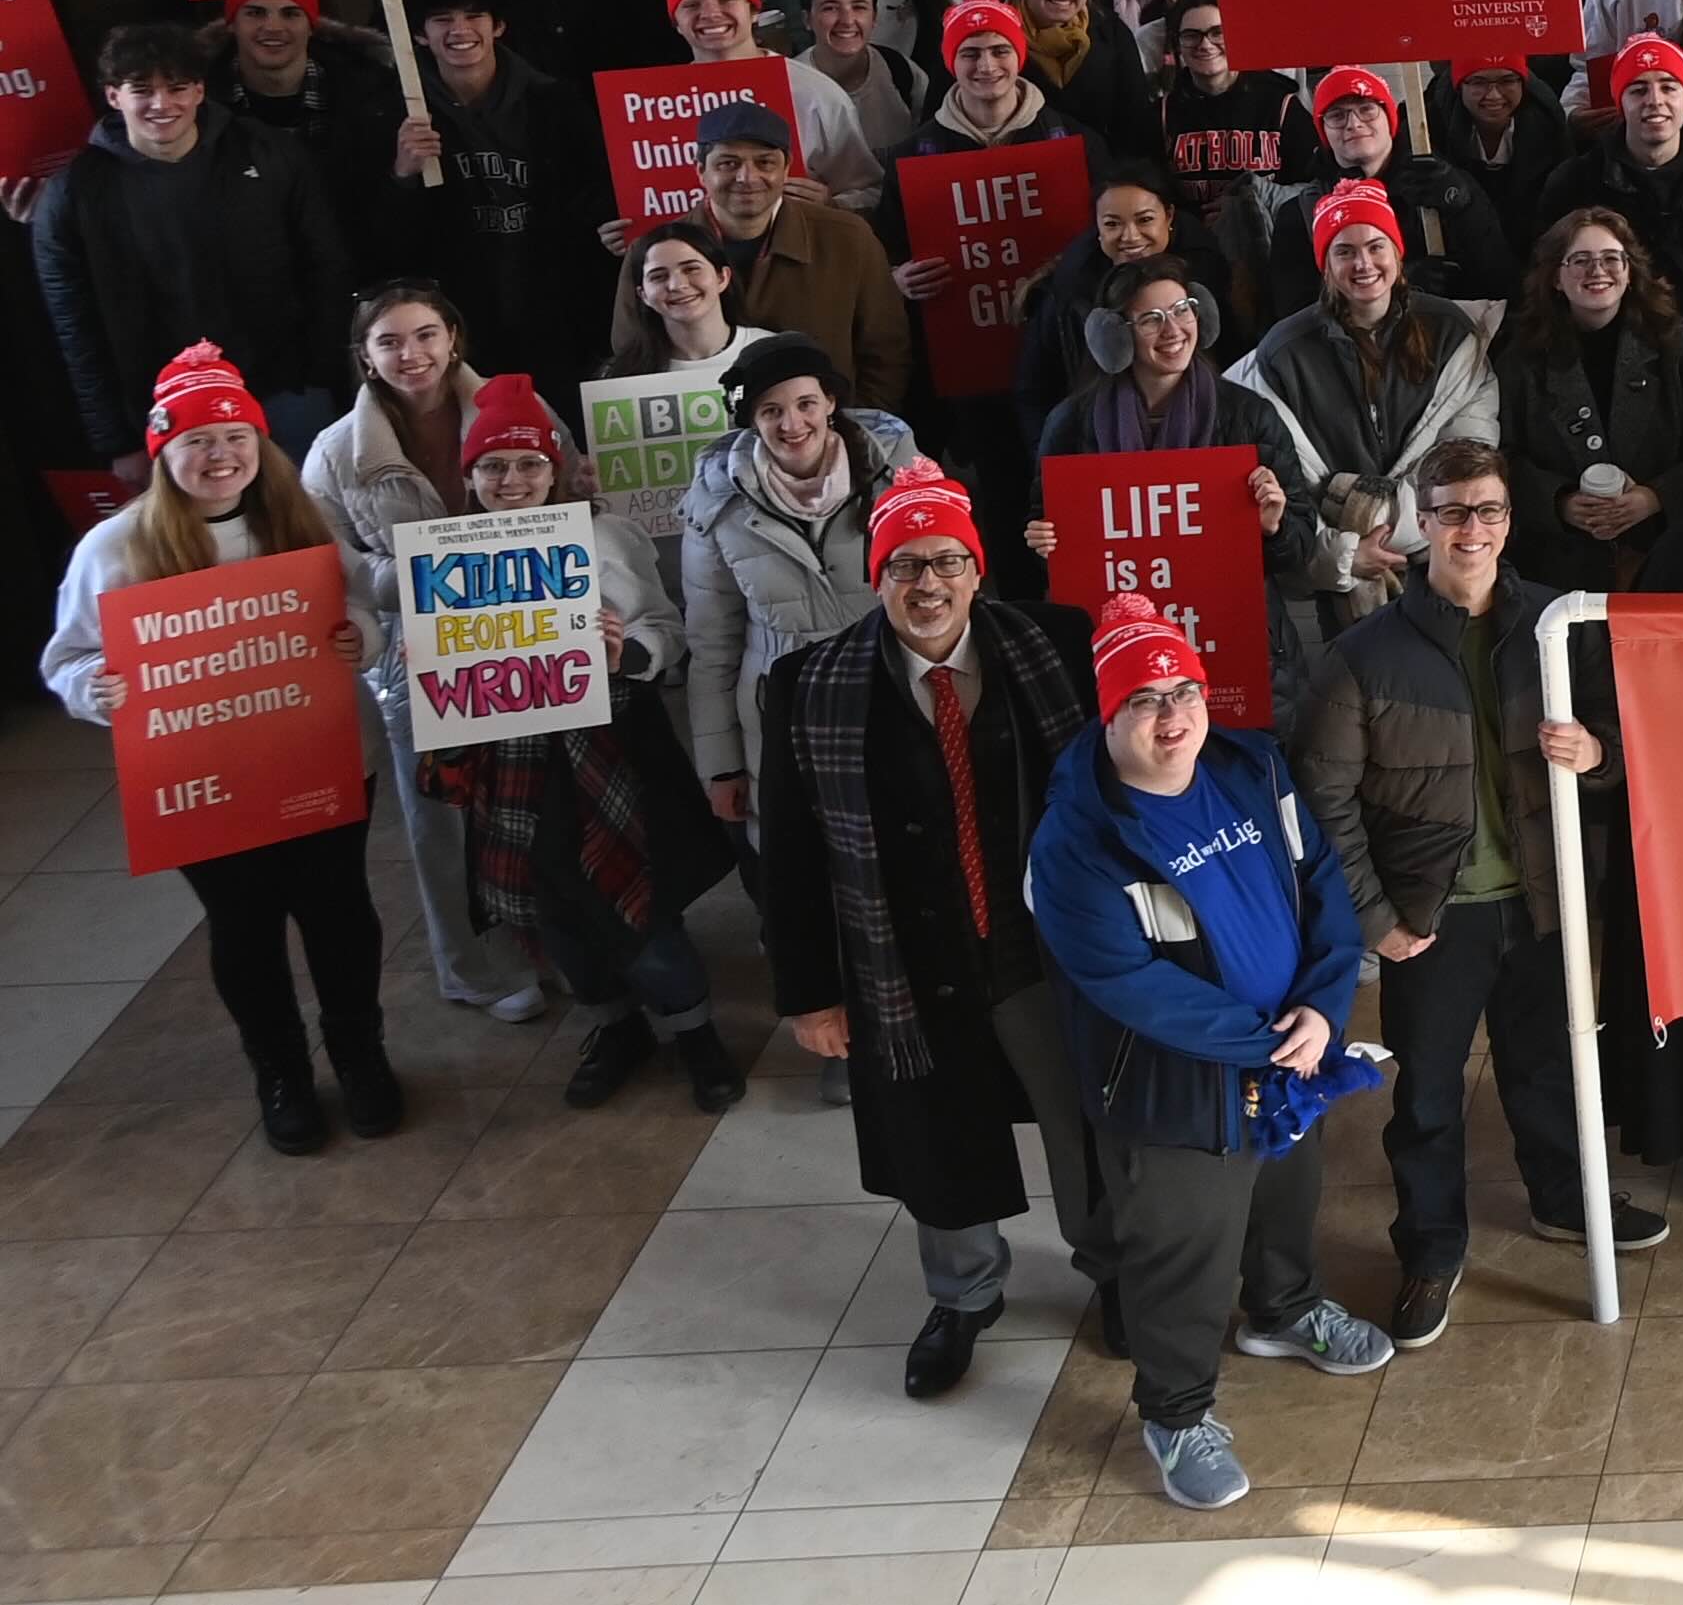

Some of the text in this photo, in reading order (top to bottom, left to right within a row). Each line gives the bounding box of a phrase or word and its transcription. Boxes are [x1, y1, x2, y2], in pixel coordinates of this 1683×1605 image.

[1452, 0, 1545, 16] UNIVERSITY
[1454, 16, 1521, 28] OF AMERICA
[1174, 130, 1281, 173] ATHOLIC
[951, 171, 1043, 226] LIFE
[959, 235, 1020, 270] is a
[608, 449, 678, 486] AD
[467, 517, 495, 530] UNDER
[498, 516, 512, 526] THE
[1101, 483, 1203, 540] LIFE
[410, 543, 592, 614] KILLING
[1104, 550, 1172, 592] is a
[133, 588, 310, 645] Wondrous,
[435, 607, 560, 656] PEOPLE
[1163, 602, 1217, 653] ft.
[139, 630, 319, 692] Incredible,
[416, 649, 592, 720] WRONG
[147, 682, 312, 739] Awesome,
[156, 775, 233, 817] LIFE.
